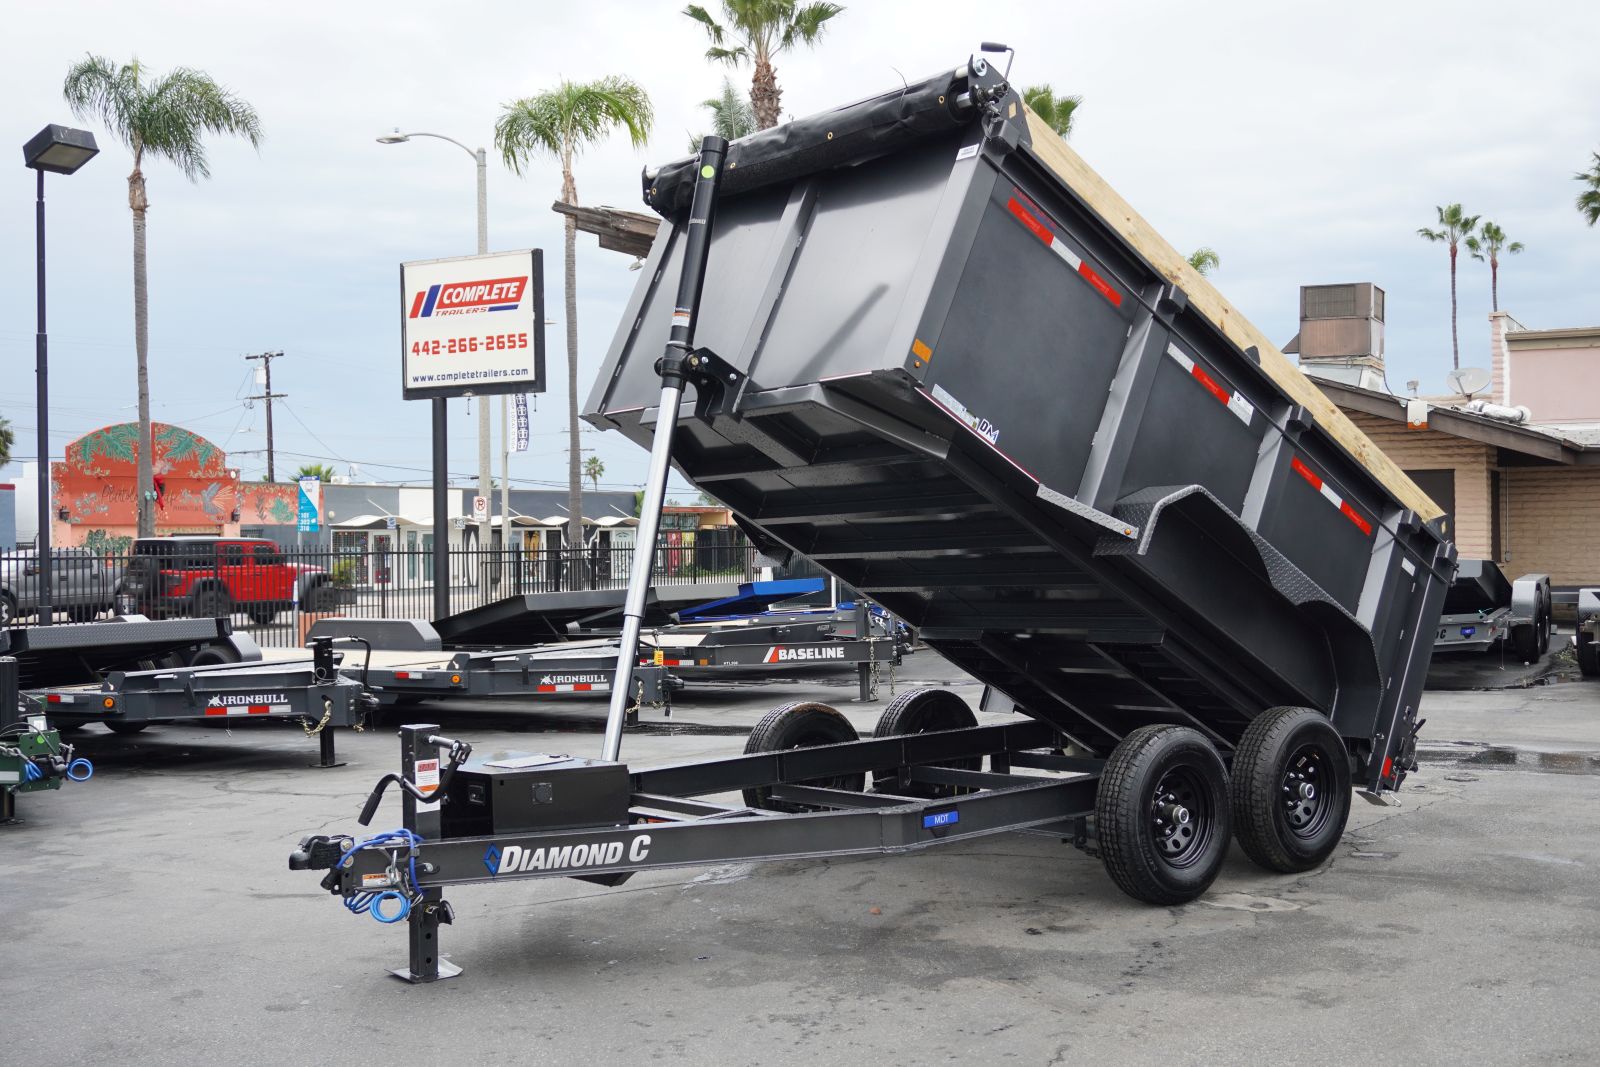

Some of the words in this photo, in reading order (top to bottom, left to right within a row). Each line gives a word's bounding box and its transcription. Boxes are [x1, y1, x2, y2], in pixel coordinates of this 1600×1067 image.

[442, 281, 520, 304] COMPLETE
[435, 306, 488, 317] TRAILERS
[411, 332, 528, 356] 442-266-2655
[412, 368, 529, 383] www.completetrailers.com
[778, 647, 845, 660] BASELINE
[553, 674, 607, 684] IRONBULL
[222, 694, 288, 705] IRONBULL
[934, 814, 949, 824] MDT
[628, 834, 651, 862] C
